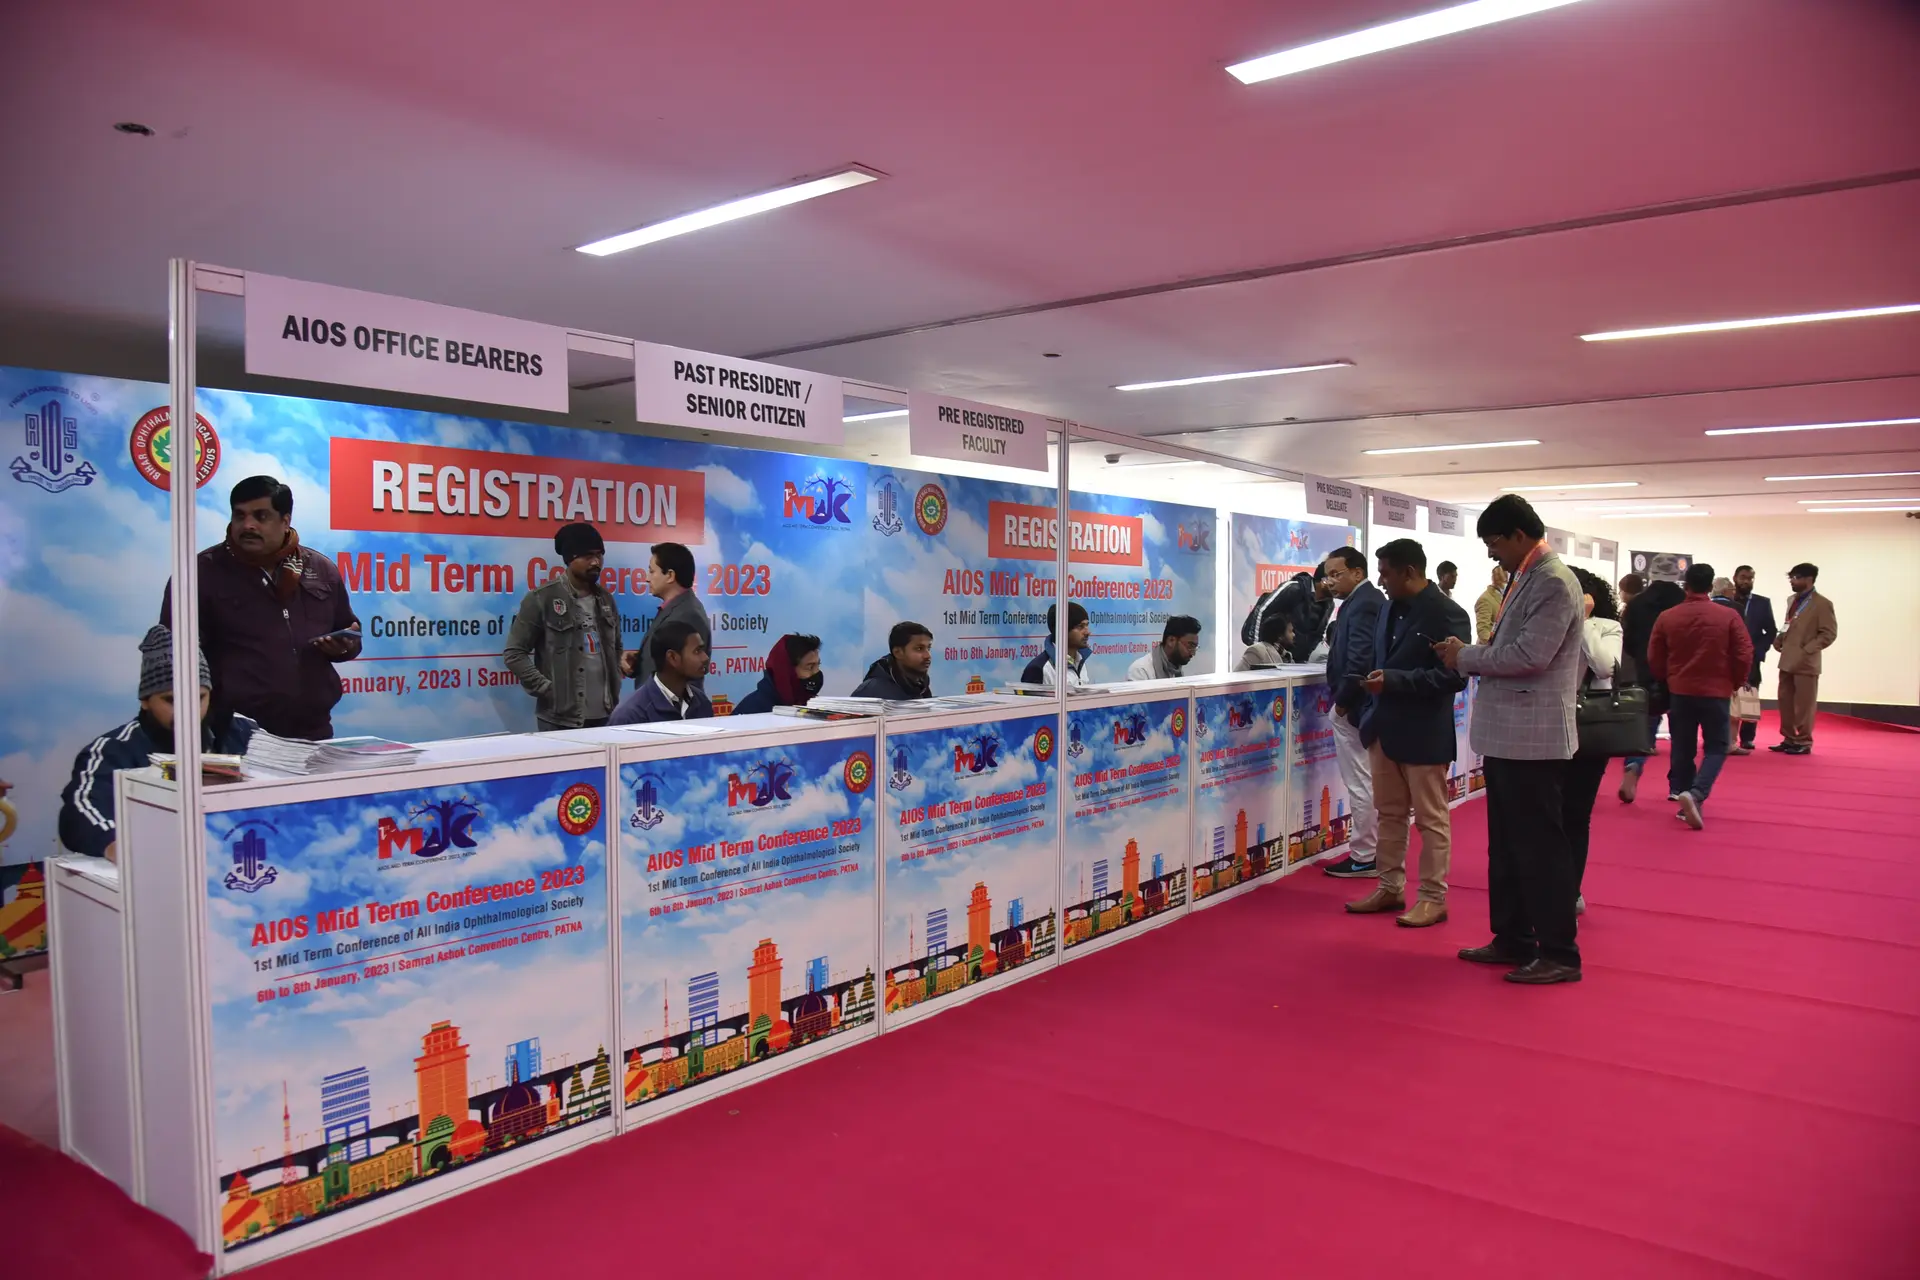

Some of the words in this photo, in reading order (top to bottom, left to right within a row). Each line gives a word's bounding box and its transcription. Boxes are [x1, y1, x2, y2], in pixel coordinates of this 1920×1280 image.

[282, 314, 347, 347] AIOS
[353, 325, 439, 361] OFFICE
[445, 340, 543, 377] BEARERS
[673, 360, 714, 385] PAST
[719, 367, 802, 400] PRESIDENT
[686, 393, 747, 421] SENIOR
[750, 402, 806, 428] CITIZEN
[938, 405, 960, 425] PRE
[962, 408, 1024, 435] REGISTERED
[962, 434, 1006, 455] FACULTY
[138, 453, 161, 480] BIHAR
[372, 459, 677, 527] REGISTRATION
[1316, 482, 1326, 493] PRE
[1326, 483, 1352, 499] REGISTERED
[1326, 499, 1348, 512] DELEGATE
[338, 551, 412, 594] Mid
[424, 554, 514, 594] Term
[707, 563, 771, 597] 2023
[943, 569, 984, 596] AIOS
[989, 571, 1020, 597] Mid
[1067, 574, 1140, 600] Conference
[1144, 578, 1173, 600] 2023
[1261, 569, 1277, 590] KIT
[371, 615, 481, 638] Conference
[488, 615, 504, 636] of
[721, 613, 769, 634] Society
[943, 610, 957, 625] 1st
[960, 610, 976, 625] Mid
[979, 610, 1000, 625] Term
[1002, 610, 1047, 625] Conference
[1091, 611, 1148, 626] Ophthalmological
[945, 647, 958, 660] 6th
[960, 647, 968, 659] to
[971, 646, 983, 659] 8th
[985, 646, 1018, 660] January,
[1021, 644, 1038, 657] 2023
[1092, 641, 1128, 654] Convention
[341, 674, 411, 696] anuary,
[418, 668, 461, 690] 2023
[726, 656, 766, 674] PATNA
[1075, 772, 1092, 787] AIOS
[1110, 767, 1127, 780] Term
[900, 807, 925, 826] AIOS
[928, 803, 946, 819] Mid
[949, 800, 972, 815] Term
[975, 789, 1024, 810] Conference
[647, 848, 684, 873] AIOS
[687, 843, 716, 865] Mid
[720, 839, 754, 858] Term
[757, 825, 829, 852] Conference
[832, 817, 862, 838] 2023
[921, 829, 934, 837] Term
[648, 881, 660, 892] 1st
[662, 879, 677, 890] Mid
[679, 875, 698, 886] Term
[700, 866, 741, 882] Conference
[743, 863, 750, 873] of
[751, 860, 761, 872] All
[763, 857, 780, 868] India
[781, 846, 837, 867] Ophthalmological
[838, 842, 860, 854] Society
[251, 914, 309, 947] AIOS
[316, 905, 360, 935] Mid
[366, 899, 419, 925] Term
[426, 878, 536, 914] Conference
[541, 865, 585, 892] 2023
[663, 904, 671, 914] to
[717, 889, 734, 902] 2023
[253, 958, 273, 972] 1st
[276, 954, 300, 968] Mid
[303, 947, 333, 962] Term
[336, 932, 400, 955] Conference
[403, 929, 414, 942] of
[417, 925, 431, 939] All
[435, 921, 460, 934] India
[463, 902, 549, 930] Ophthalmological
[551, 896, 584, 911] Society
[257, 988, 276, 1003] 6th
[278, 985, 290, 998] to
[293, 980, 311, 995] 8th
[314, 971, 361, 990] January,
[364, 963, 389, 979] 2023
[398, 954, 434, 971] Samrat
[437, 946, 466, 963] Ashok
[468, 936, 519, 956] Convention
[521, 929, 552, 944] Centre,
[555, 921, 583, 936] PATNA
